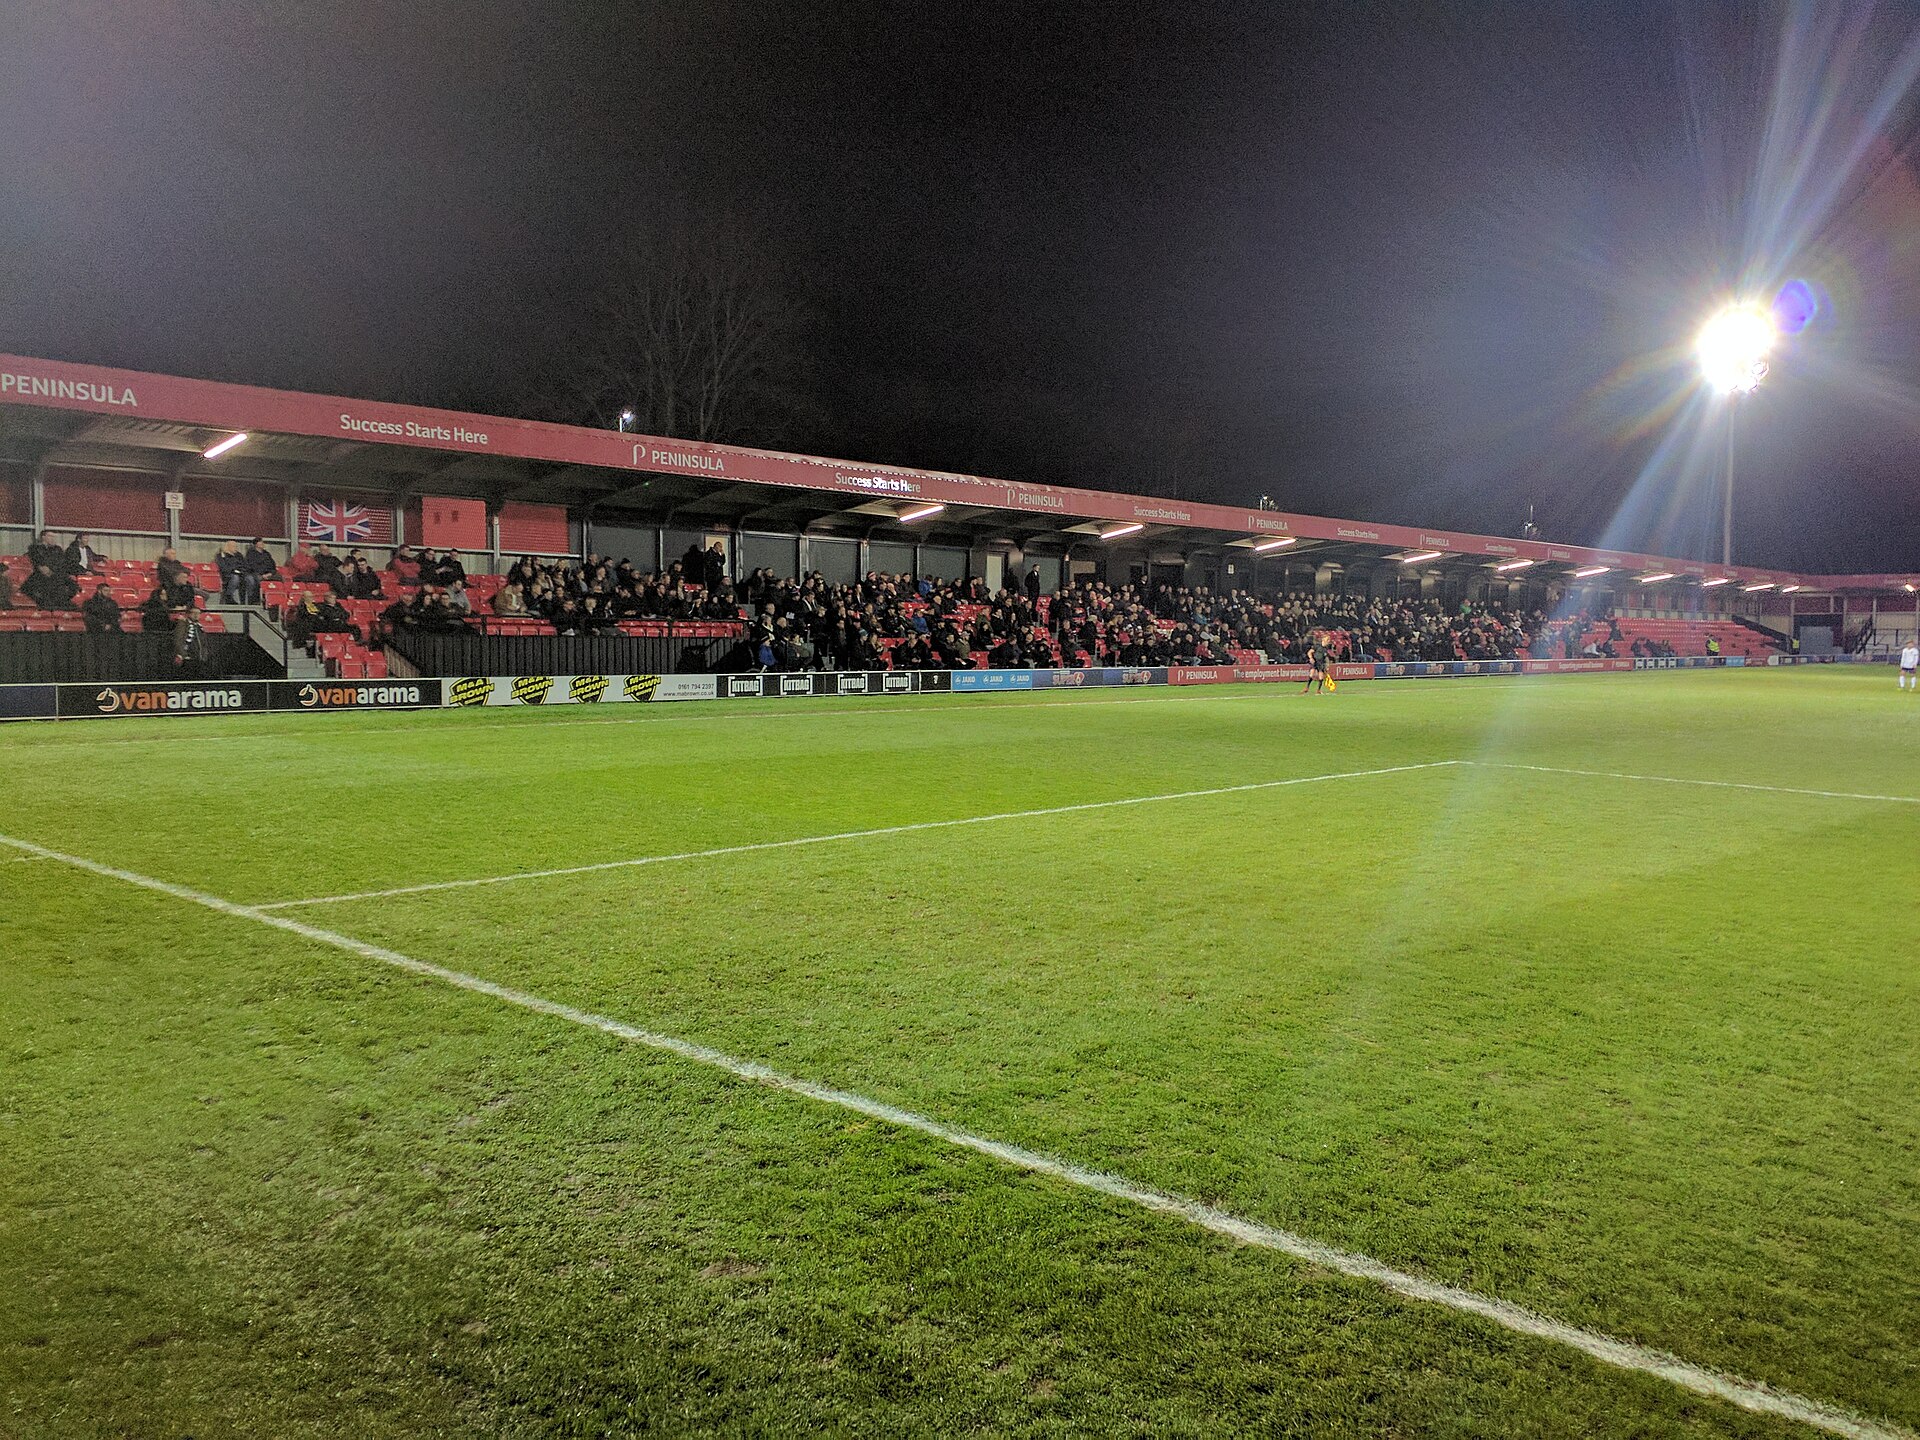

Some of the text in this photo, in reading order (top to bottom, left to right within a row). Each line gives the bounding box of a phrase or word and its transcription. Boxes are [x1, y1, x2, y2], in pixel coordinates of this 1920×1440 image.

[1, 373, 138, 407] PENINSULA
[340, 414, 488, 444] Success Starts Here
[652, 450, 724, 472] PENINSULA
[835, 472, 921, 493] Success Starts Here
[1018, 493, 1064, 508] PENINSULA
[1134, 505, 1191, 521] Success Starts Here
[1256, 518, 1288, 531] PENINSULA
[1186, 670, 1217, 680] PENINSULA
[1233, 669, 1245, 678] The
[319, 686, 420, 704] vanarama
[450, 683, 494, 703] BROWN
[512, 679, 554, 699] BROWN
[569, 679, 609, 698] BROWN
[624, 676, 661, 695] BROWN
[120, 689, 241, 710] vanarama
